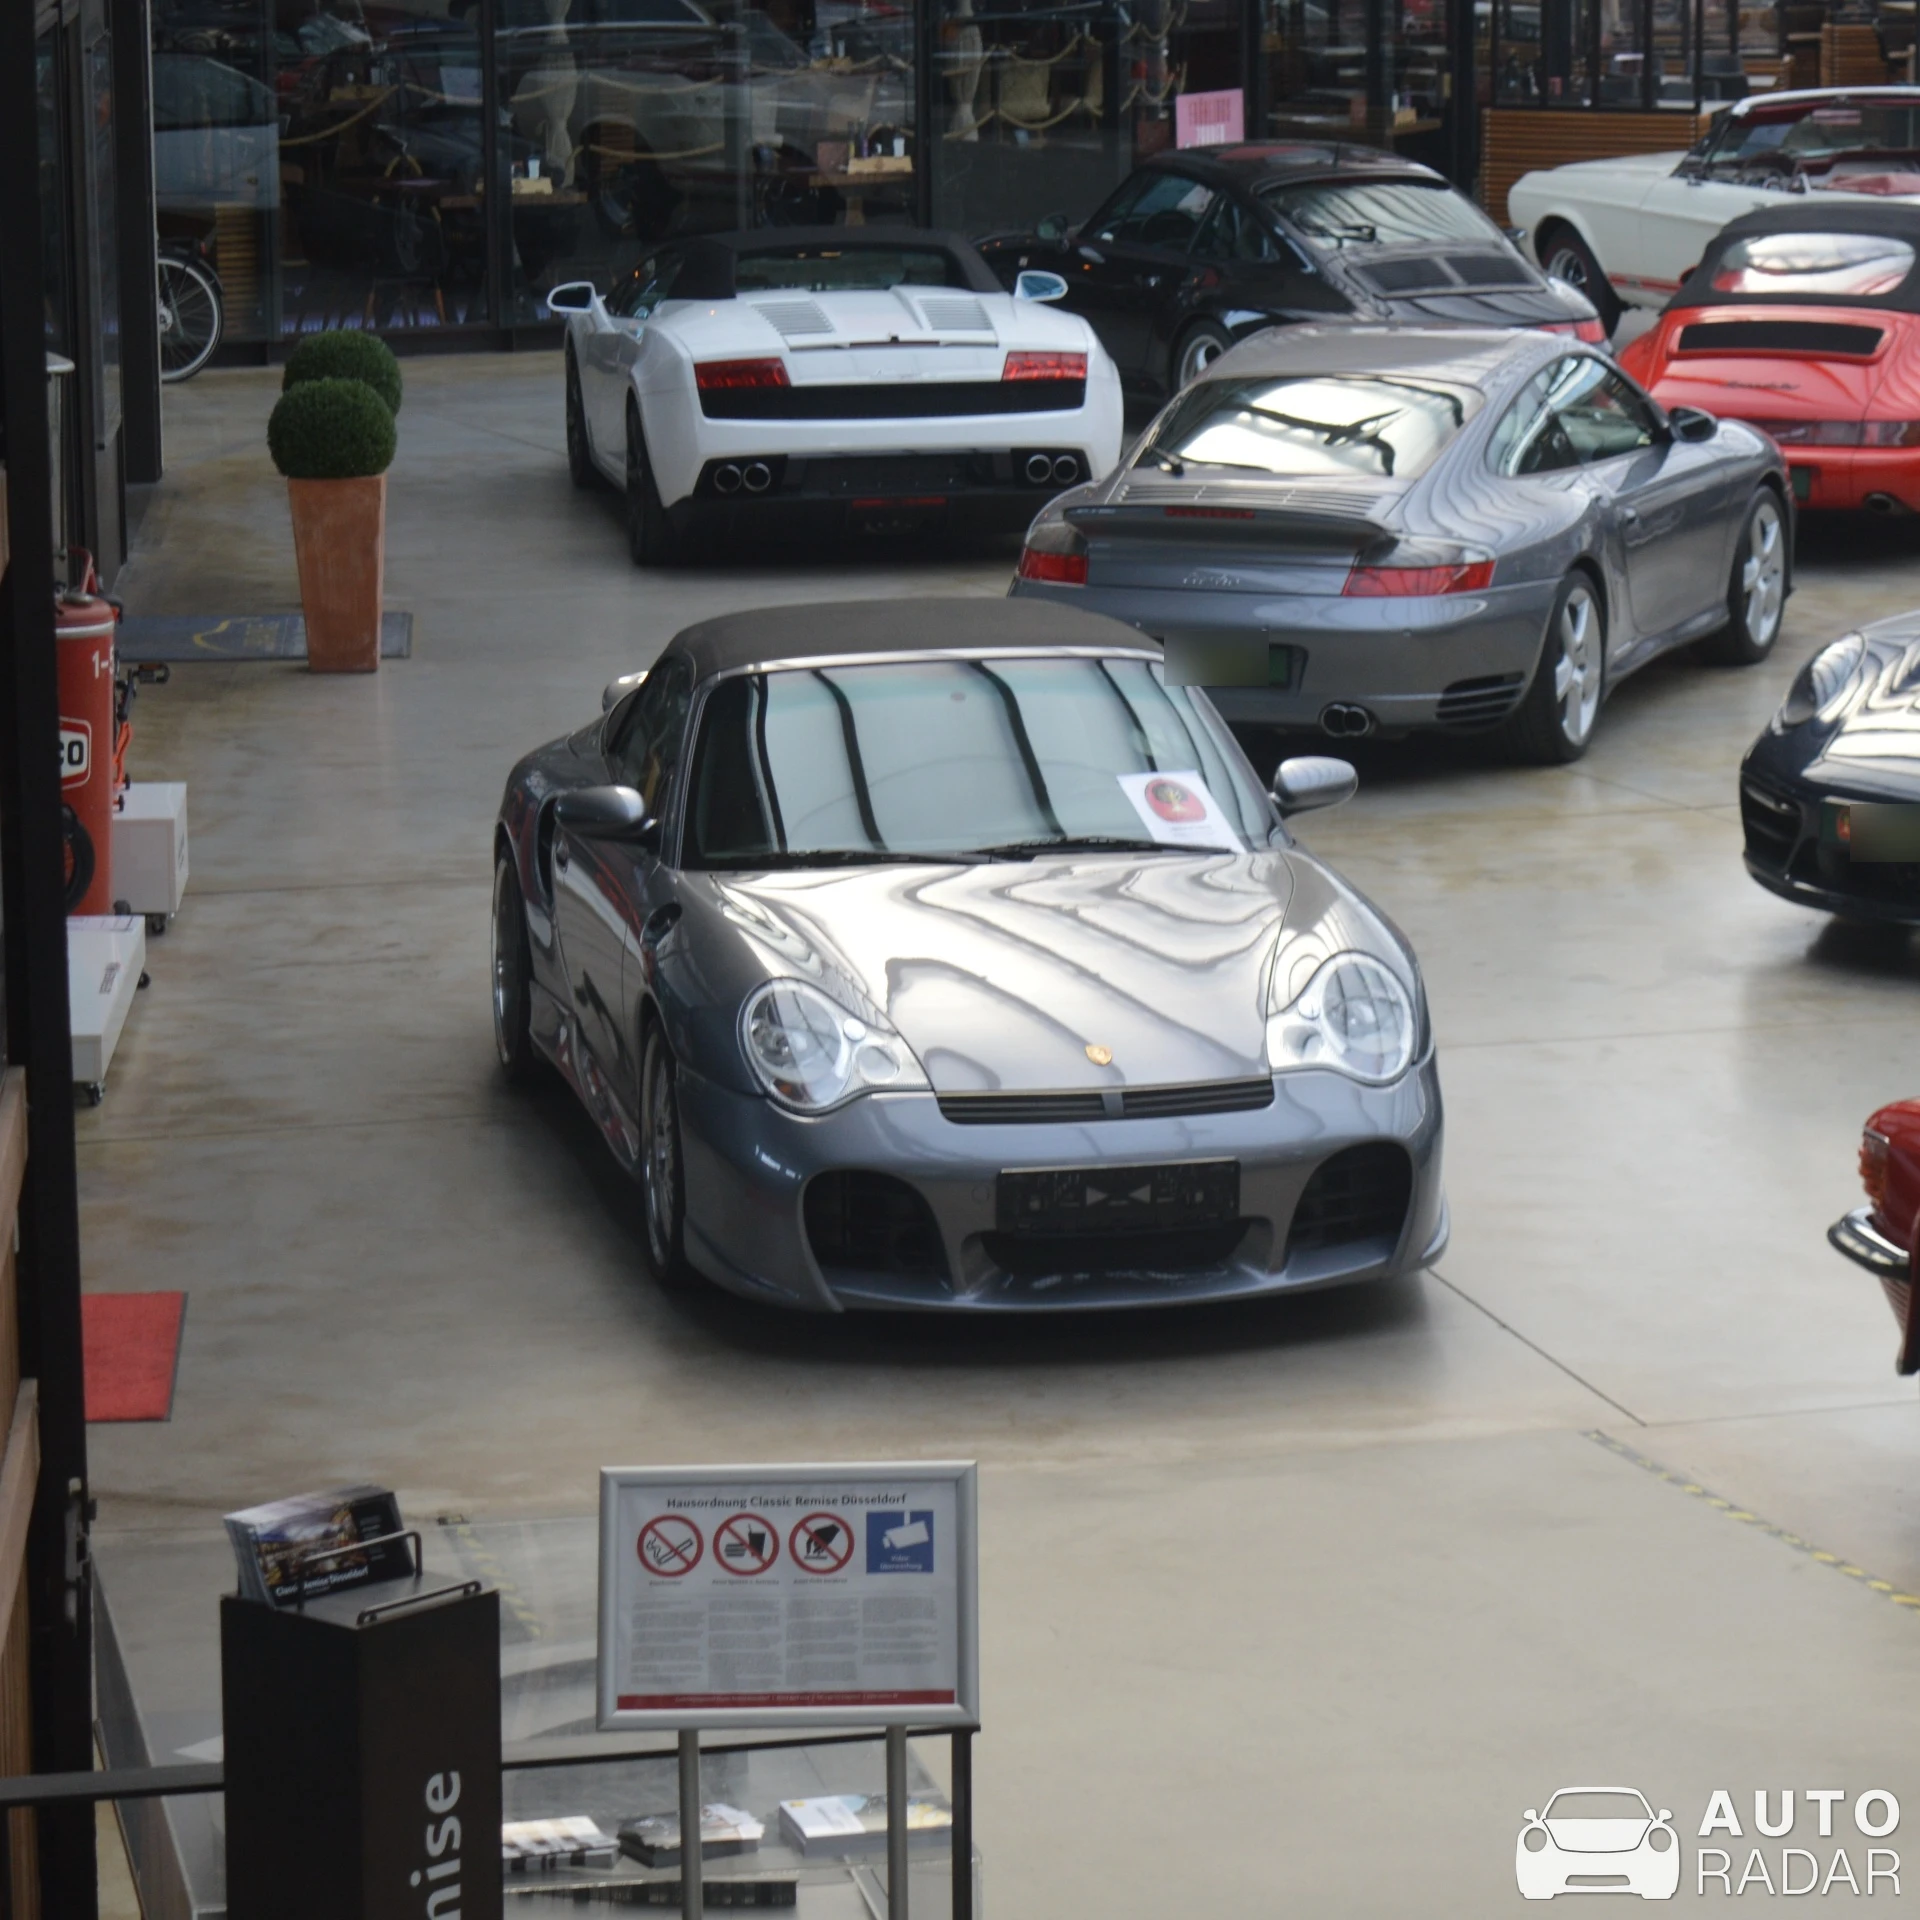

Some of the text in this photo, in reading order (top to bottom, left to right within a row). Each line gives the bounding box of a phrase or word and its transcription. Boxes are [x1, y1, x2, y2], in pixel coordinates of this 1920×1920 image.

[666, 1492, 907, 1508] Hausordnung Classic Remise Düsseldorf
